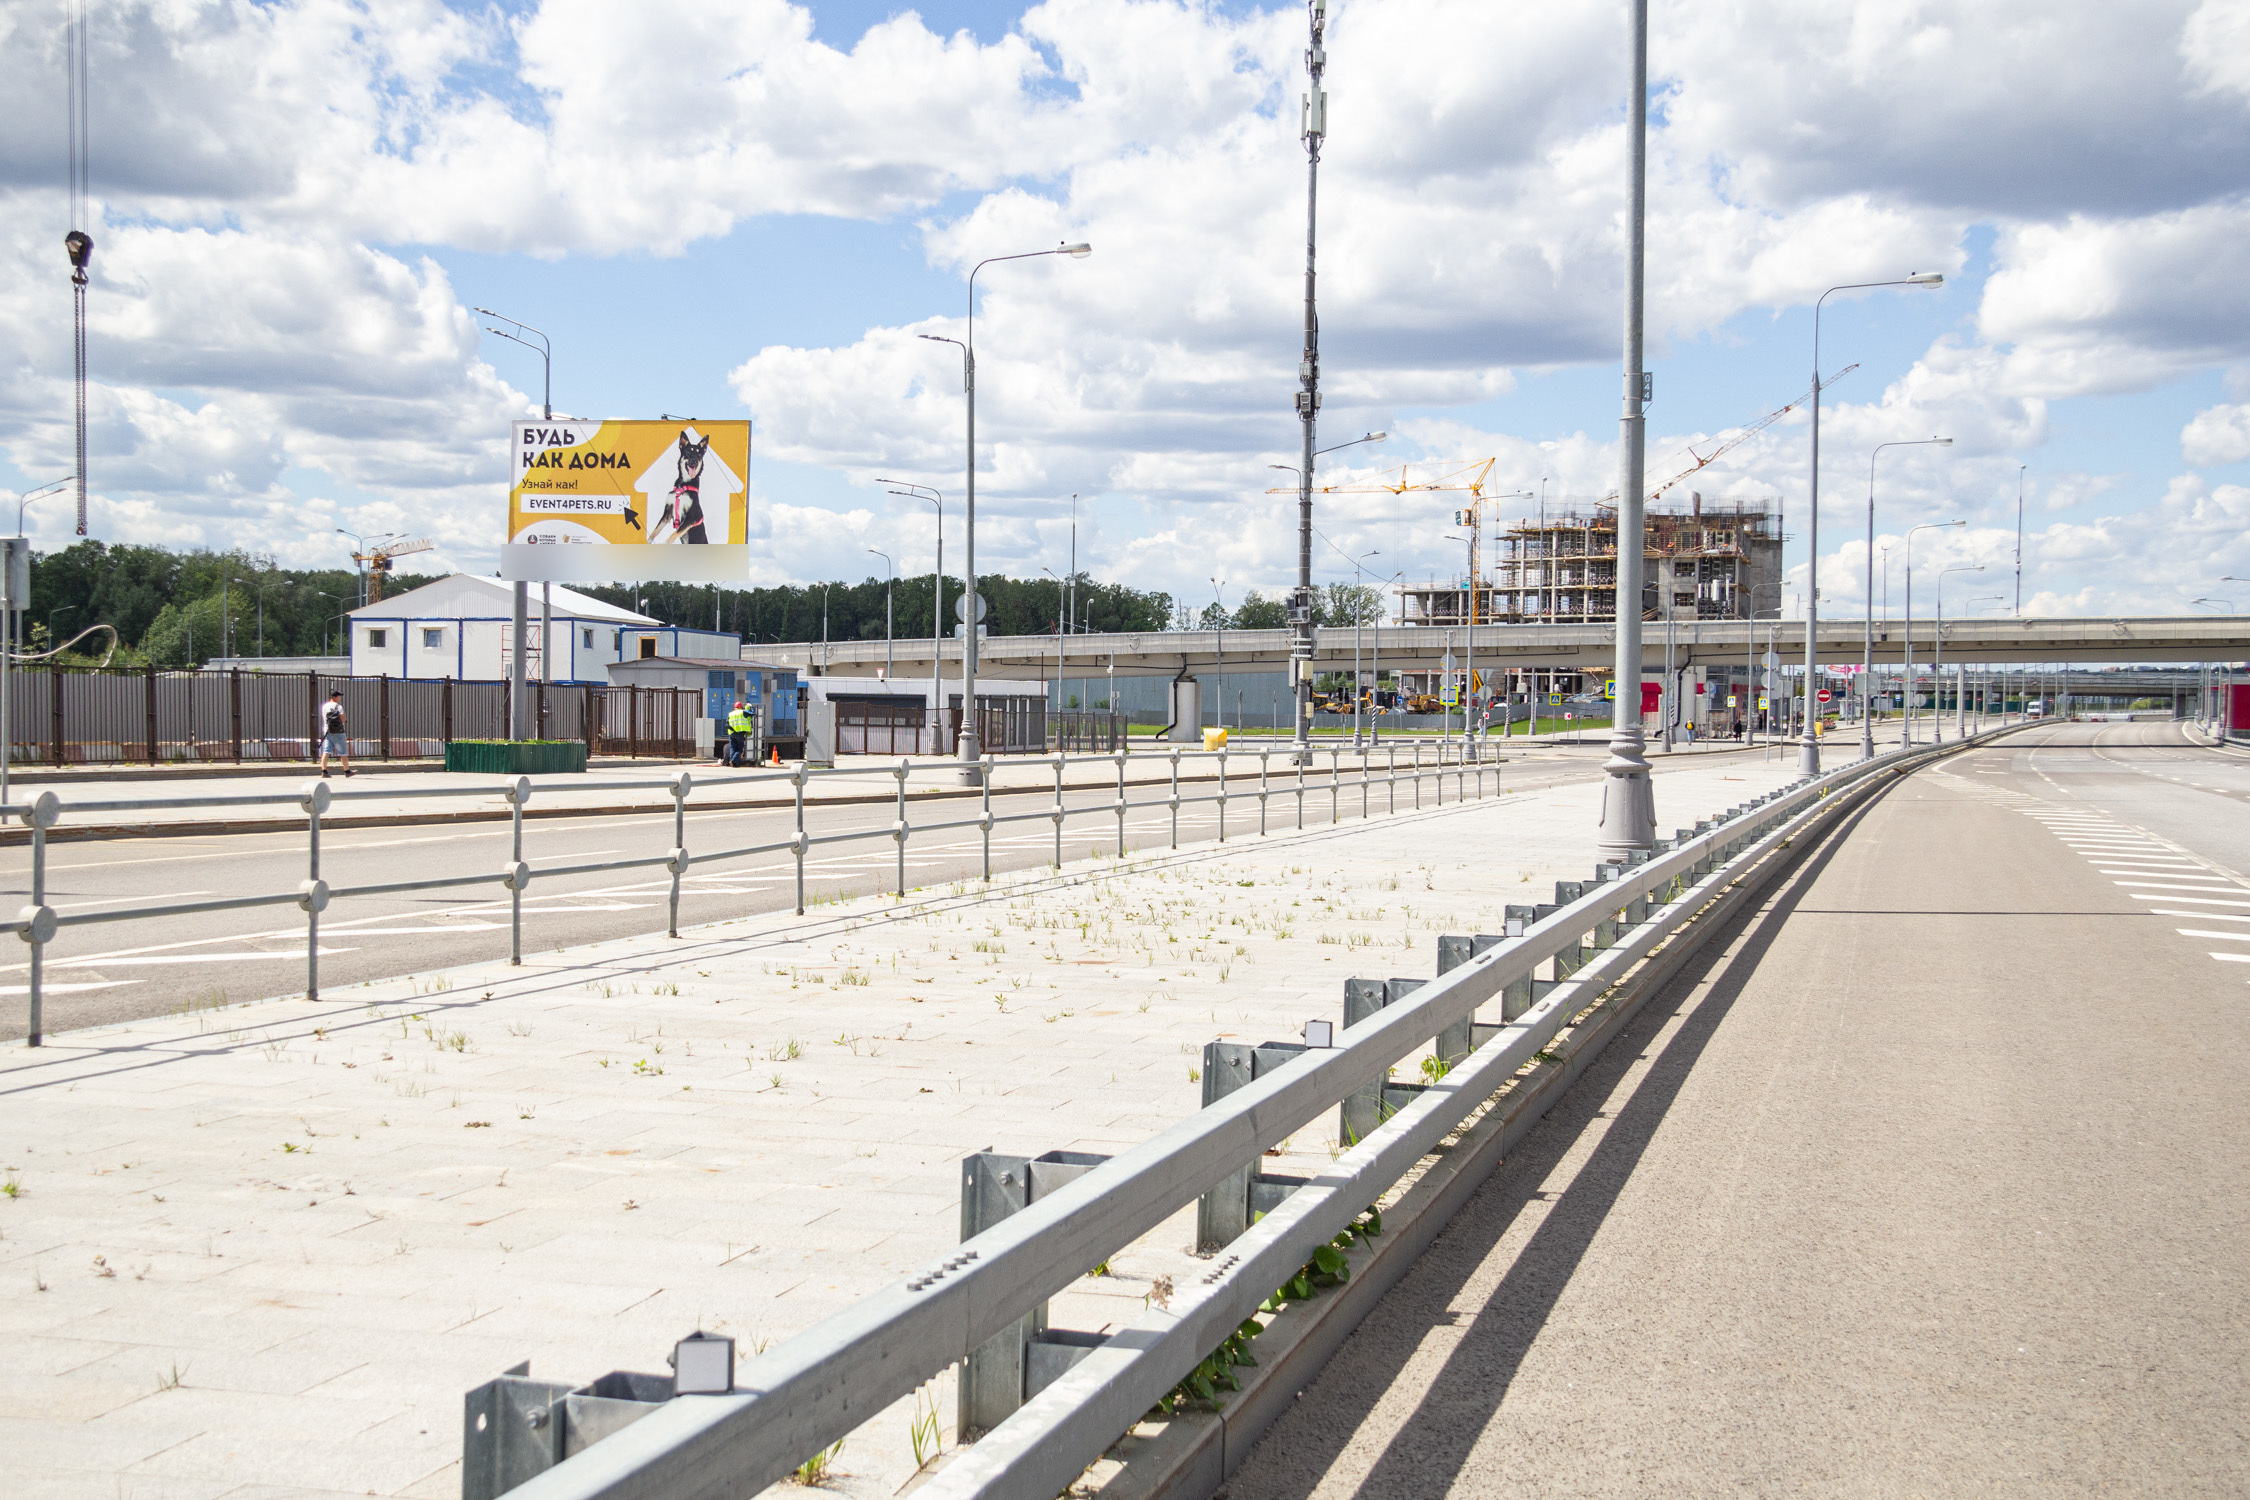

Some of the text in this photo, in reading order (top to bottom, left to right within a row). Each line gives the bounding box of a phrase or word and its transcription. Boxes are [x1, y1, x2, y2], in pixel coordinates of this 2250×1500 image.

[524, 428, 575, 446] БУДЬ
[522, 452, 632, 470] КАК ДОМА
[522, 478, 578, 490] Узнай как!
[530, 499, 612, 510] EVENT4PETS.RU
